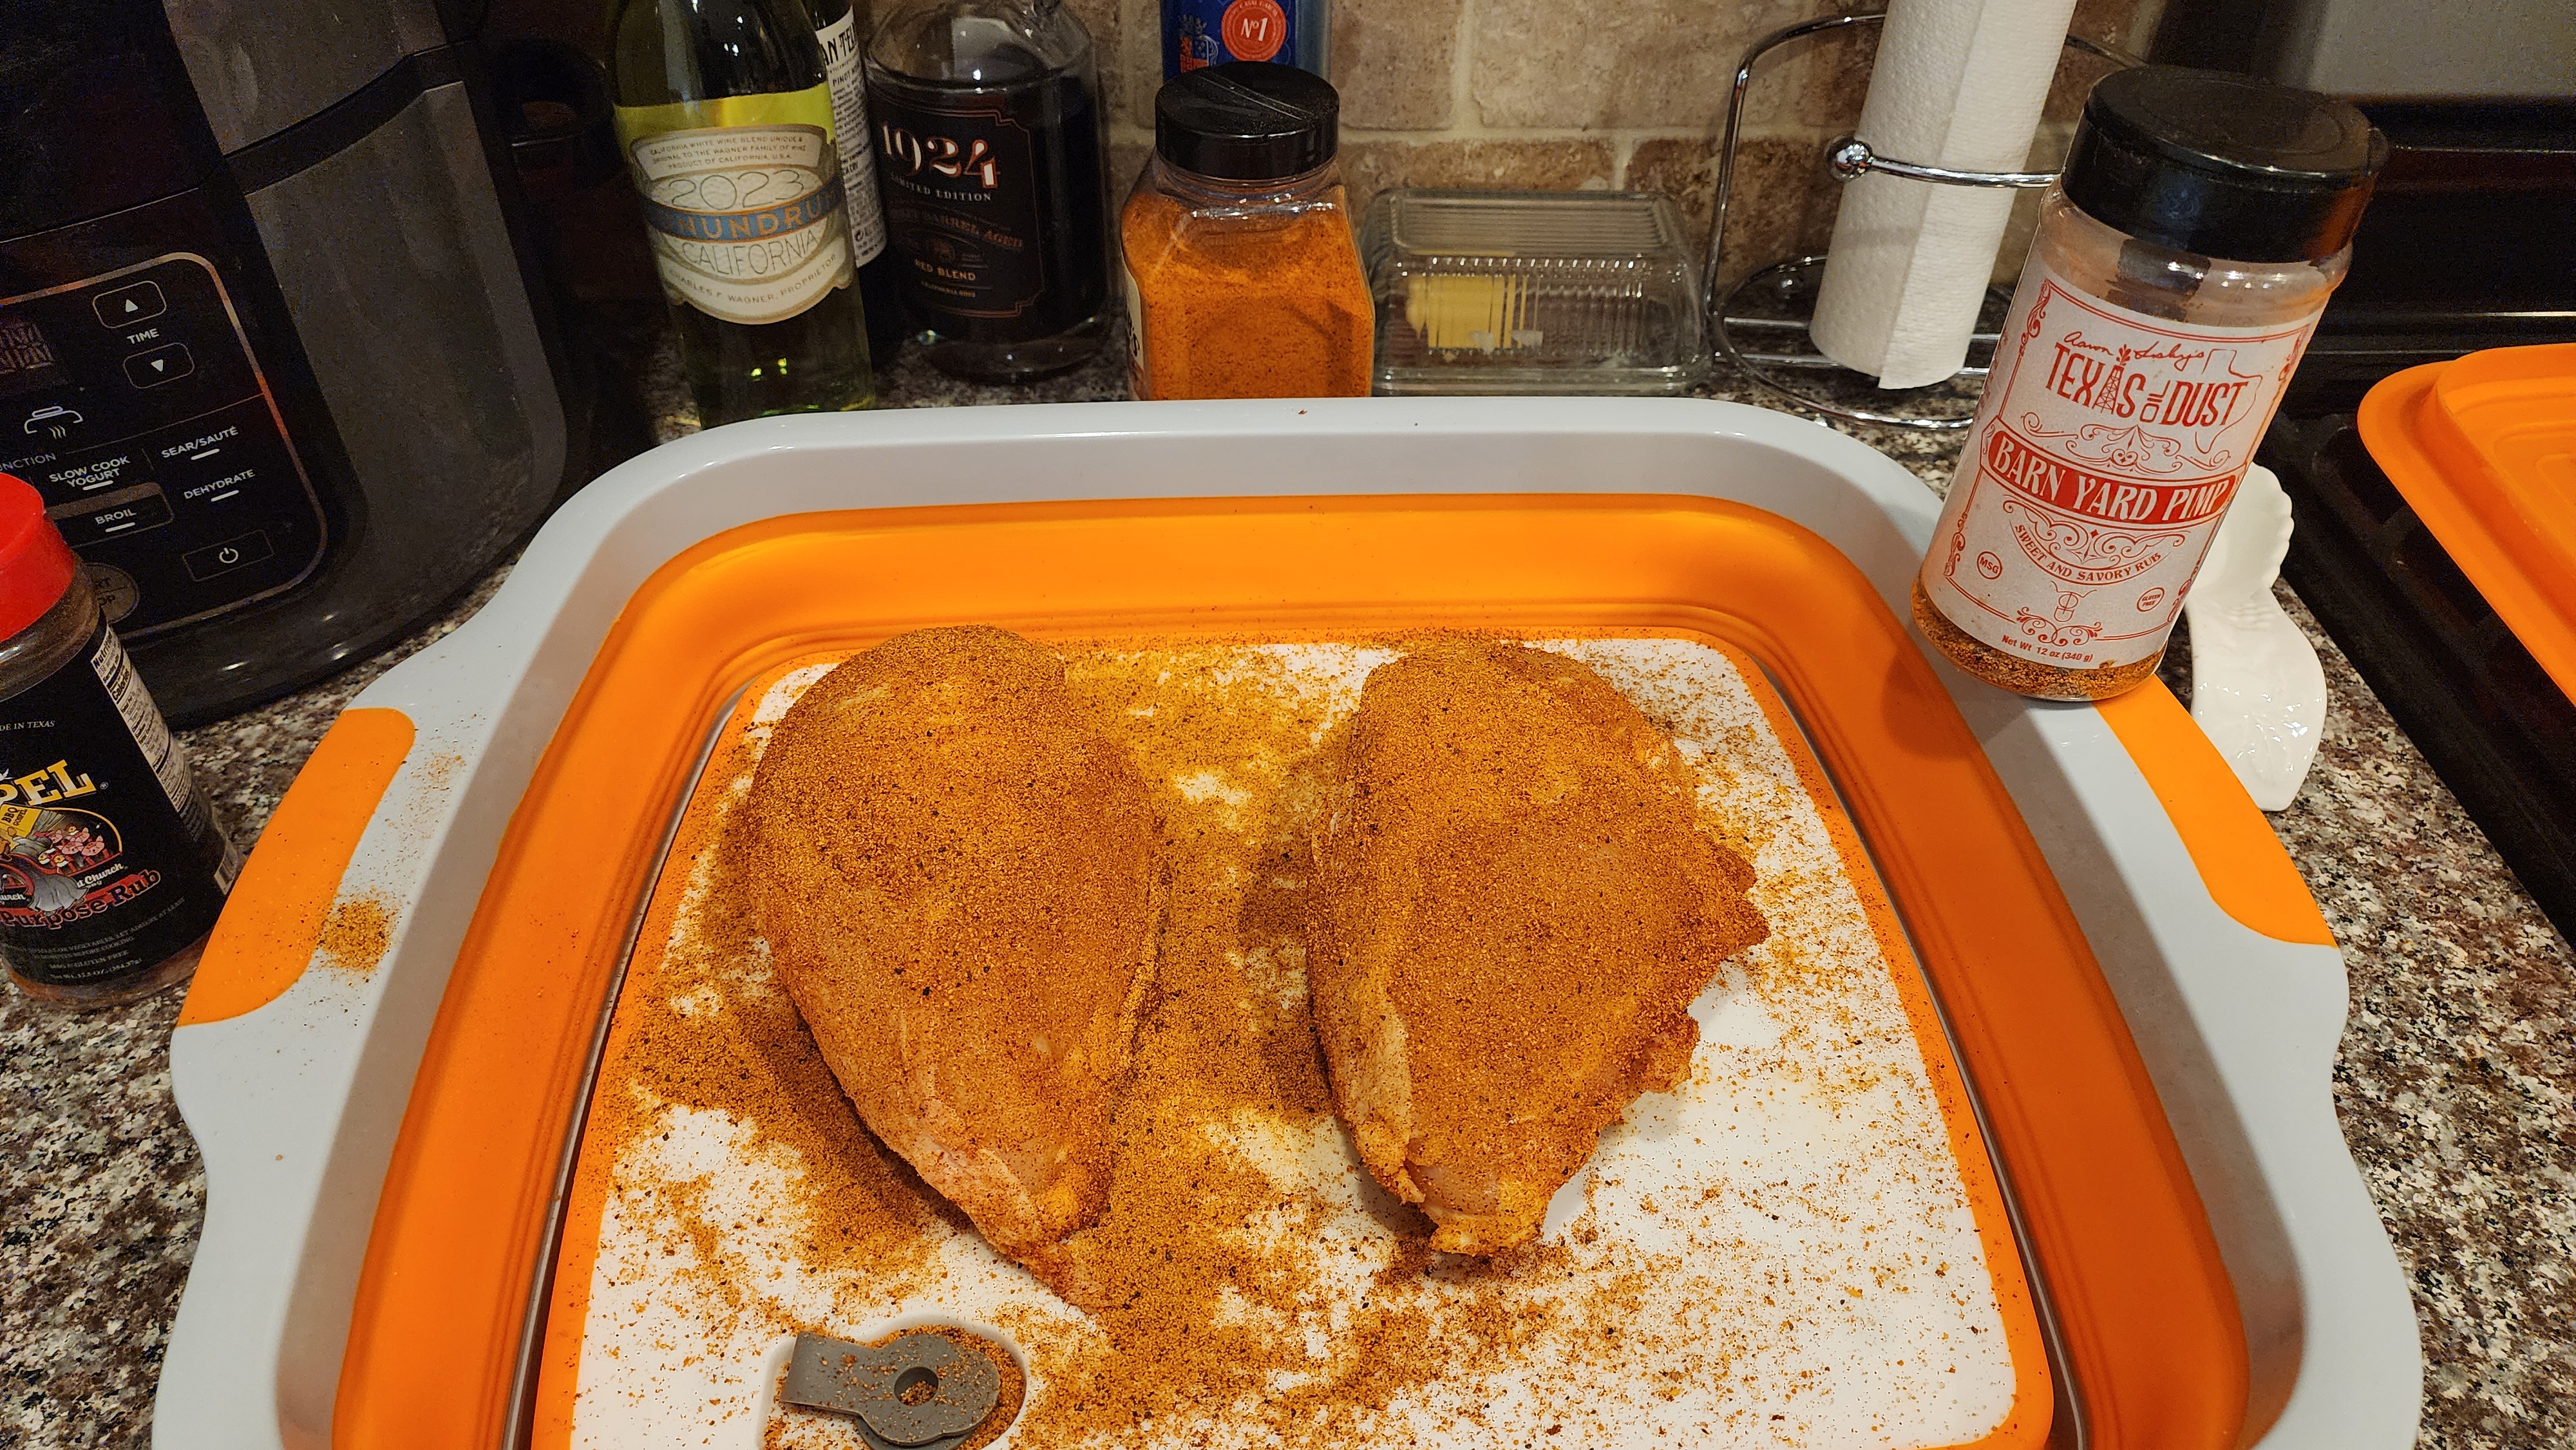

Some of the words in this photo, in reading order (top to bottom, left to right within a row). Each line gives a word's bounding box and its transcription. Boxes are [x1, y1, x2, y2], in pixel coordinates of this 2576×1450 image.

[669, 160, 702, 169] PRODUCT
[883, 122, 1001, 188] 1924
[668, 169, 804, 211] 2023
[891, 171, 931, 196] LIMITED
[936, 189, 992, 202] EDITION
[683, 229, 819, 275] CALIFORNIA
[781, 254, 836, 296] PROPRIETOR
[937, 267, 976, 281] BLEND
[127, 328, 160, 344] TIME
[2046, 342, 2146, 418] TEXAS
[2161, 381, 2249, 428] DUST
[49, 466, 88, 483] SLOW
[91, 455, 131, 472] COOK
[66, 467, 120, 487] YOGURT
[1992, 435, 2065, 502] BARN
[2072, 476, 2157, 521] YARD
[2162, 480, 2230, 522] PIMP
[183, 468, 256, 502] DEHYDRATE
[95, 508, 137, 525] BROIL
[1979, 556, 2000, 574] MSG
[2014, 524, 2047, 561] SWEET
[2046, 560, 2072, 578] AND
[2076, 567, 2132, 581] SAVORY
[2135, 552, 2161, 572] RUB
[2002, 634, 2018, 647] Net
[2020, 641, 2032, 652] Wt
[2036, 646, 2048, 655] 12
[27, 720, 55, 728] TEXAS
[0, 759, 97, 806] PEL
[1, 807, 20, 823] BBQ
[84, 863, 124, 884] Church
[0, 892, 26, 901] urch
[106, 869, 161, 907] Rub
